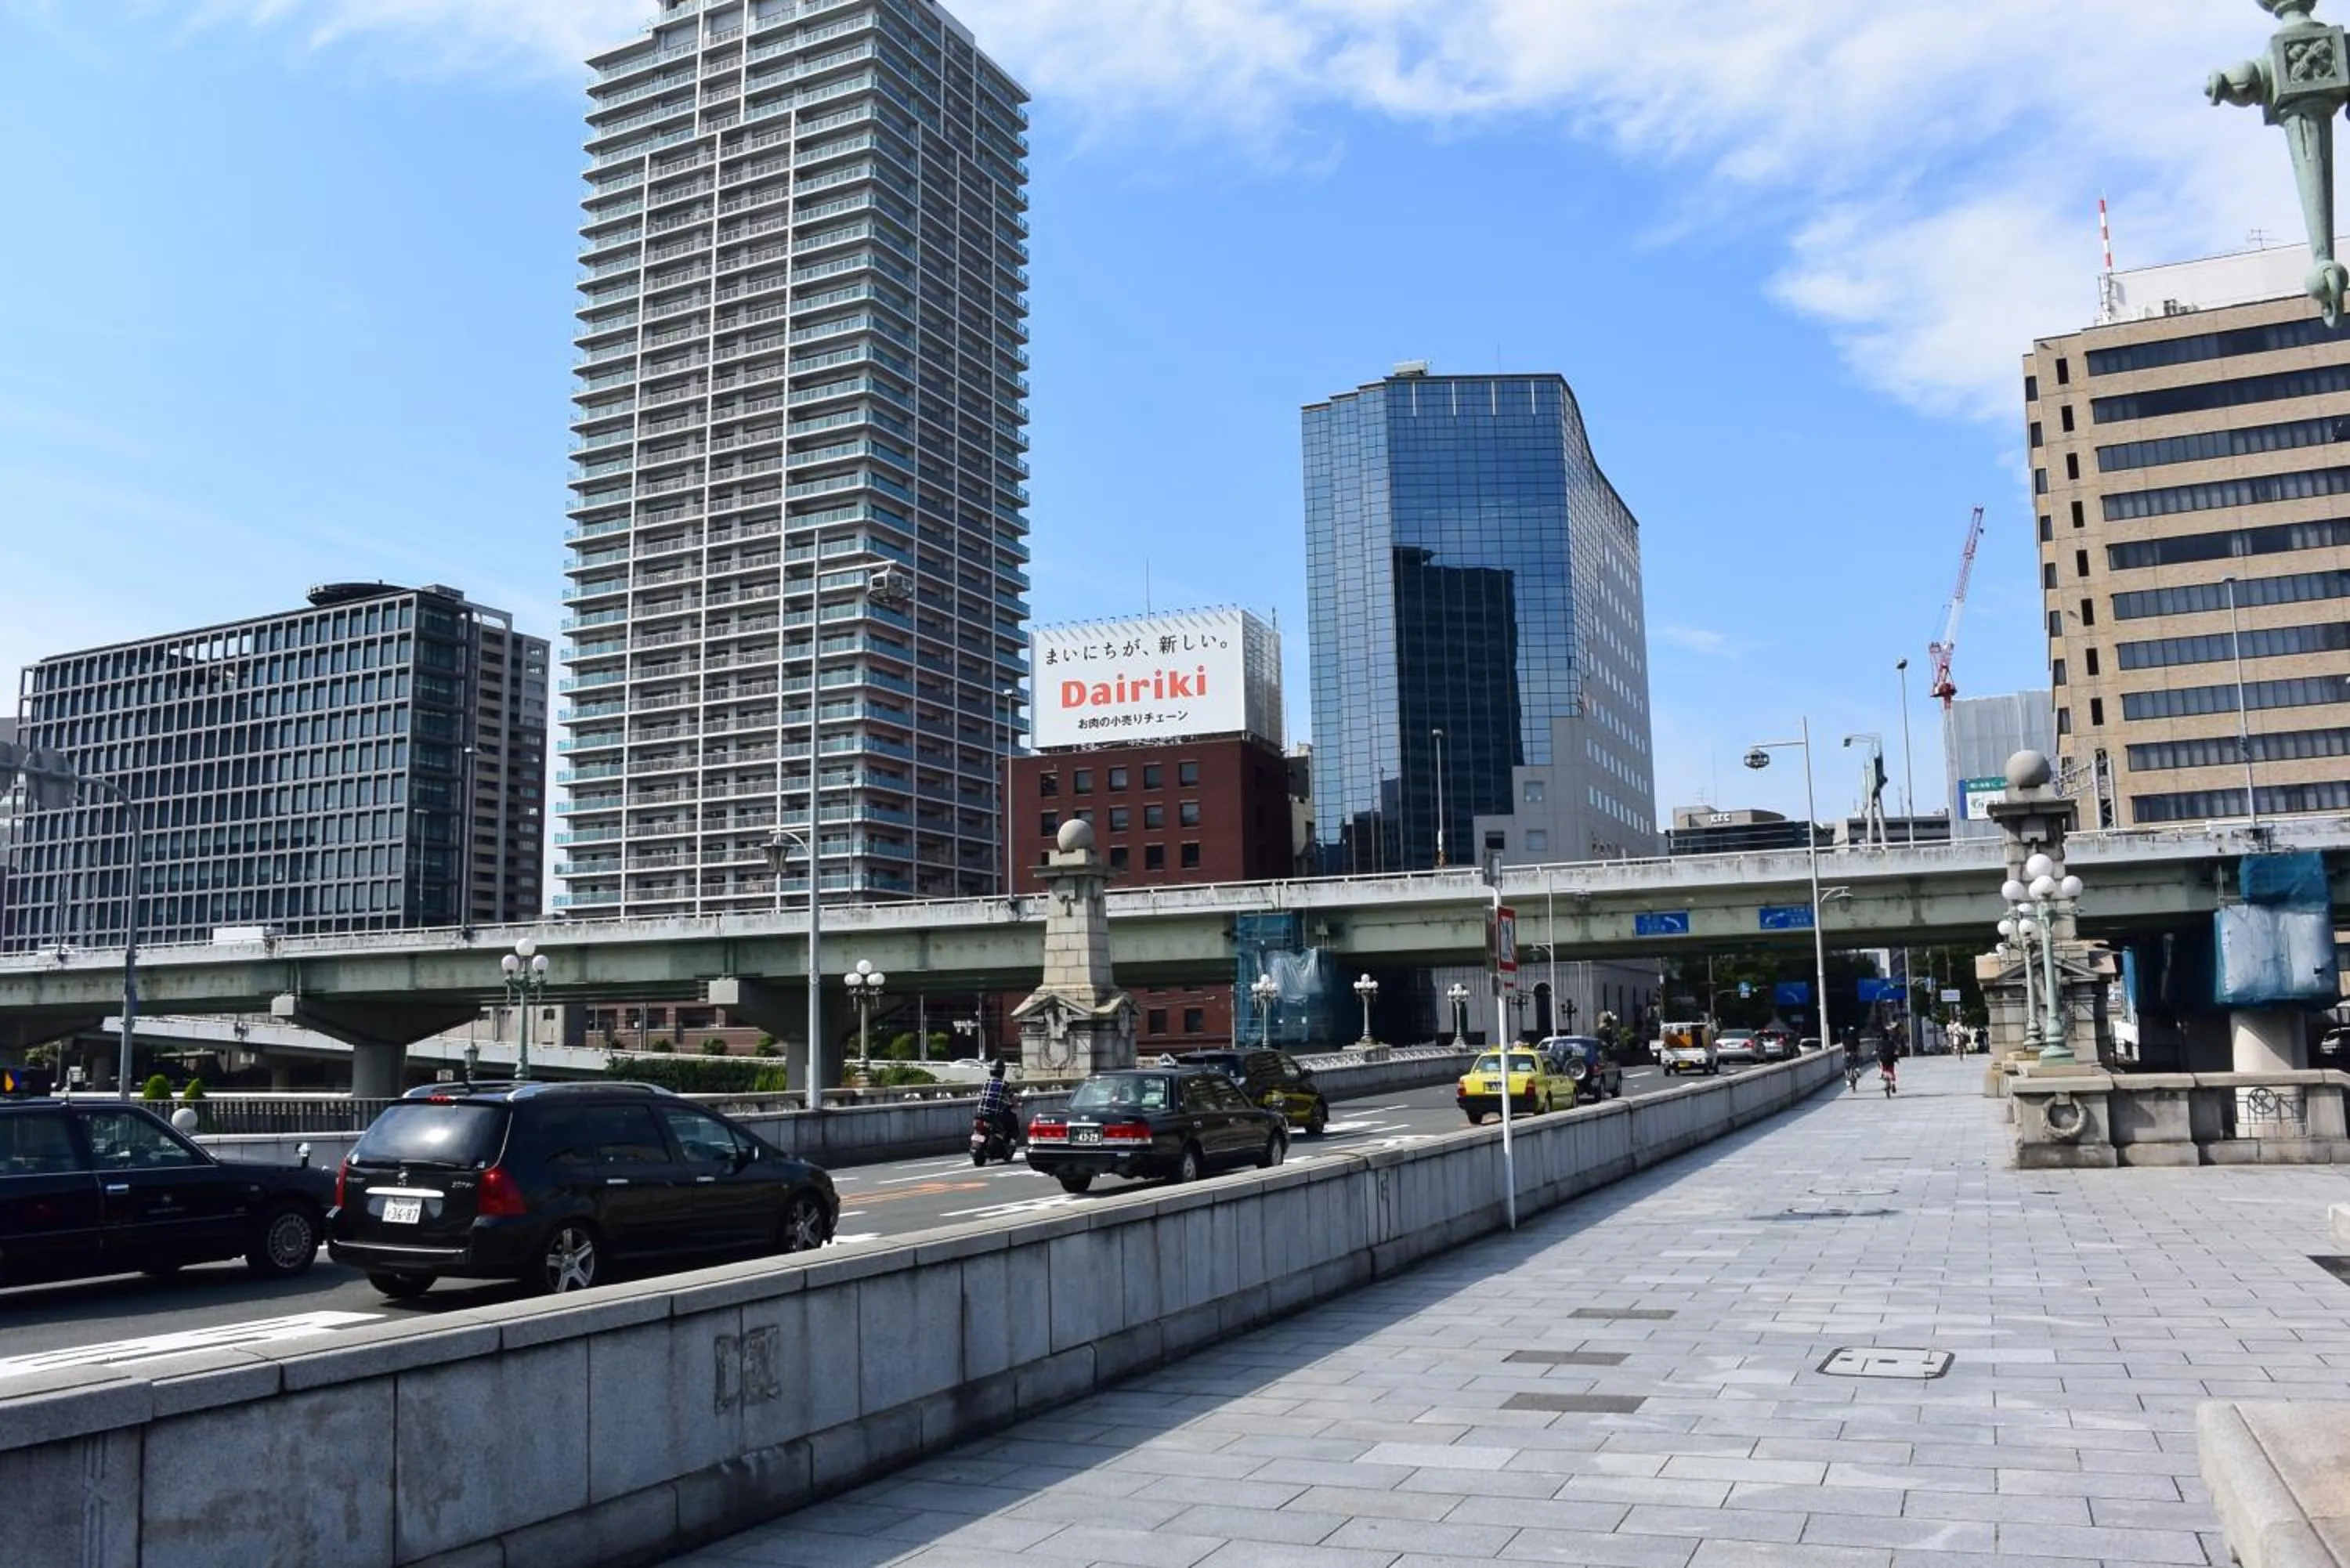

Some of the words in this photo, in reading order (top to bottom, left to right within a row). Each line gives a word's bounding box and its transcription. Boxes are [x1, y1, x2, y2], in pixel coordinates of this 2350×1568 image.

[1045, 633, 1228, 665] まいにちが、新しい。
[1061, 665, 1206, 709] Dairiki
[1078, 710, 1189, 729] お肉の小売りチェーン
